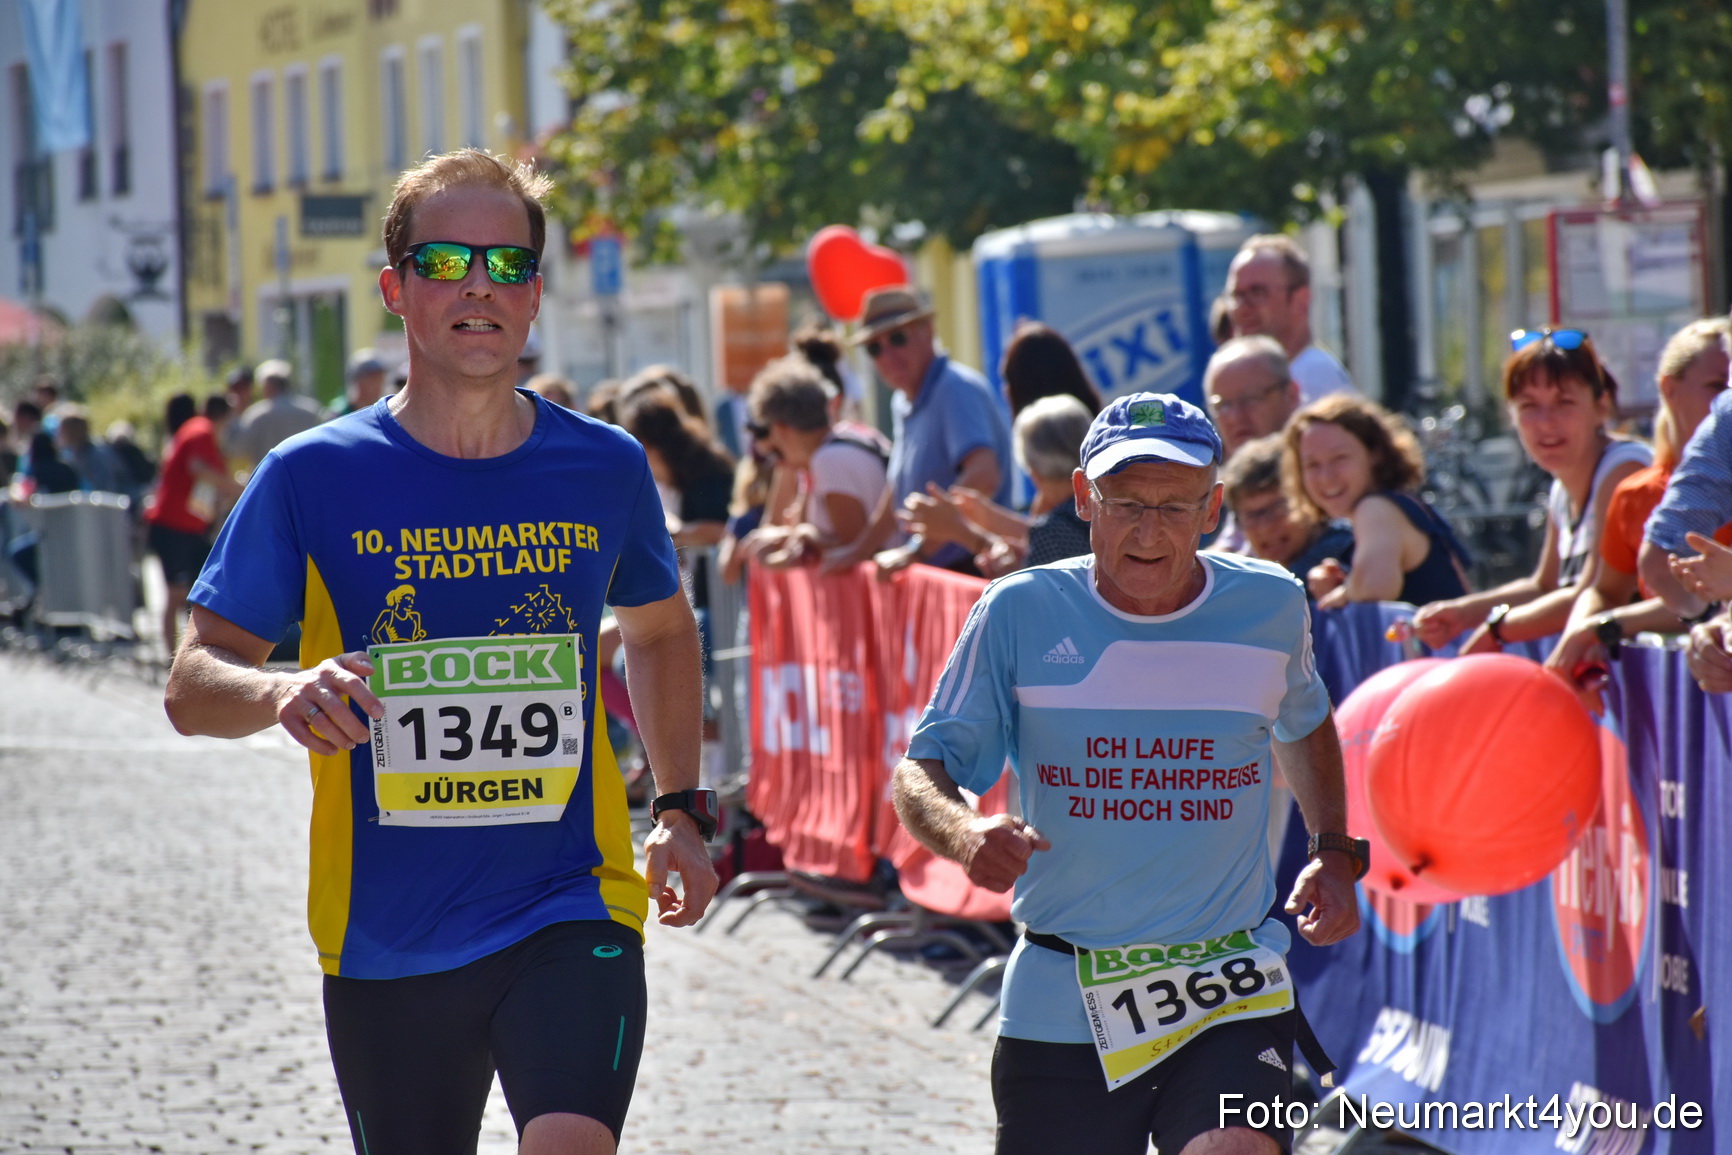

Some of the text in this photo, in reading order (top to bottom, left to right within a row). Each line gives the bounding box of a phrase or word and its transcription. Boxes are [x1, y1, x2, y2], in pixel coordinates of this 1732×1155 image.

[351, 521, 599, 555] 10. NEUMARKTER
[394, 548, 571, 580] STADTLAUF
[386, 646, 558, 687] BOCK
[1042, 654, 1085, 665] adidas
[563, 706, 573, 716] B
[397, 702, 559, 761] 1349
[1086, 737, 1214, 760] ICH LAUFE
[414, 776, 544, 804] JÜRGEN
[1037, 762, 1261, 790] WEIL DIE FAHRPREISE
[1069, 796, 1233, 821] ZU HOCH SIND
[1092, 936, 1240, 977] BOCK
[1111, 957, 1266, 1035] 1368
[1258, 1054, 1287, 1071] adidas
